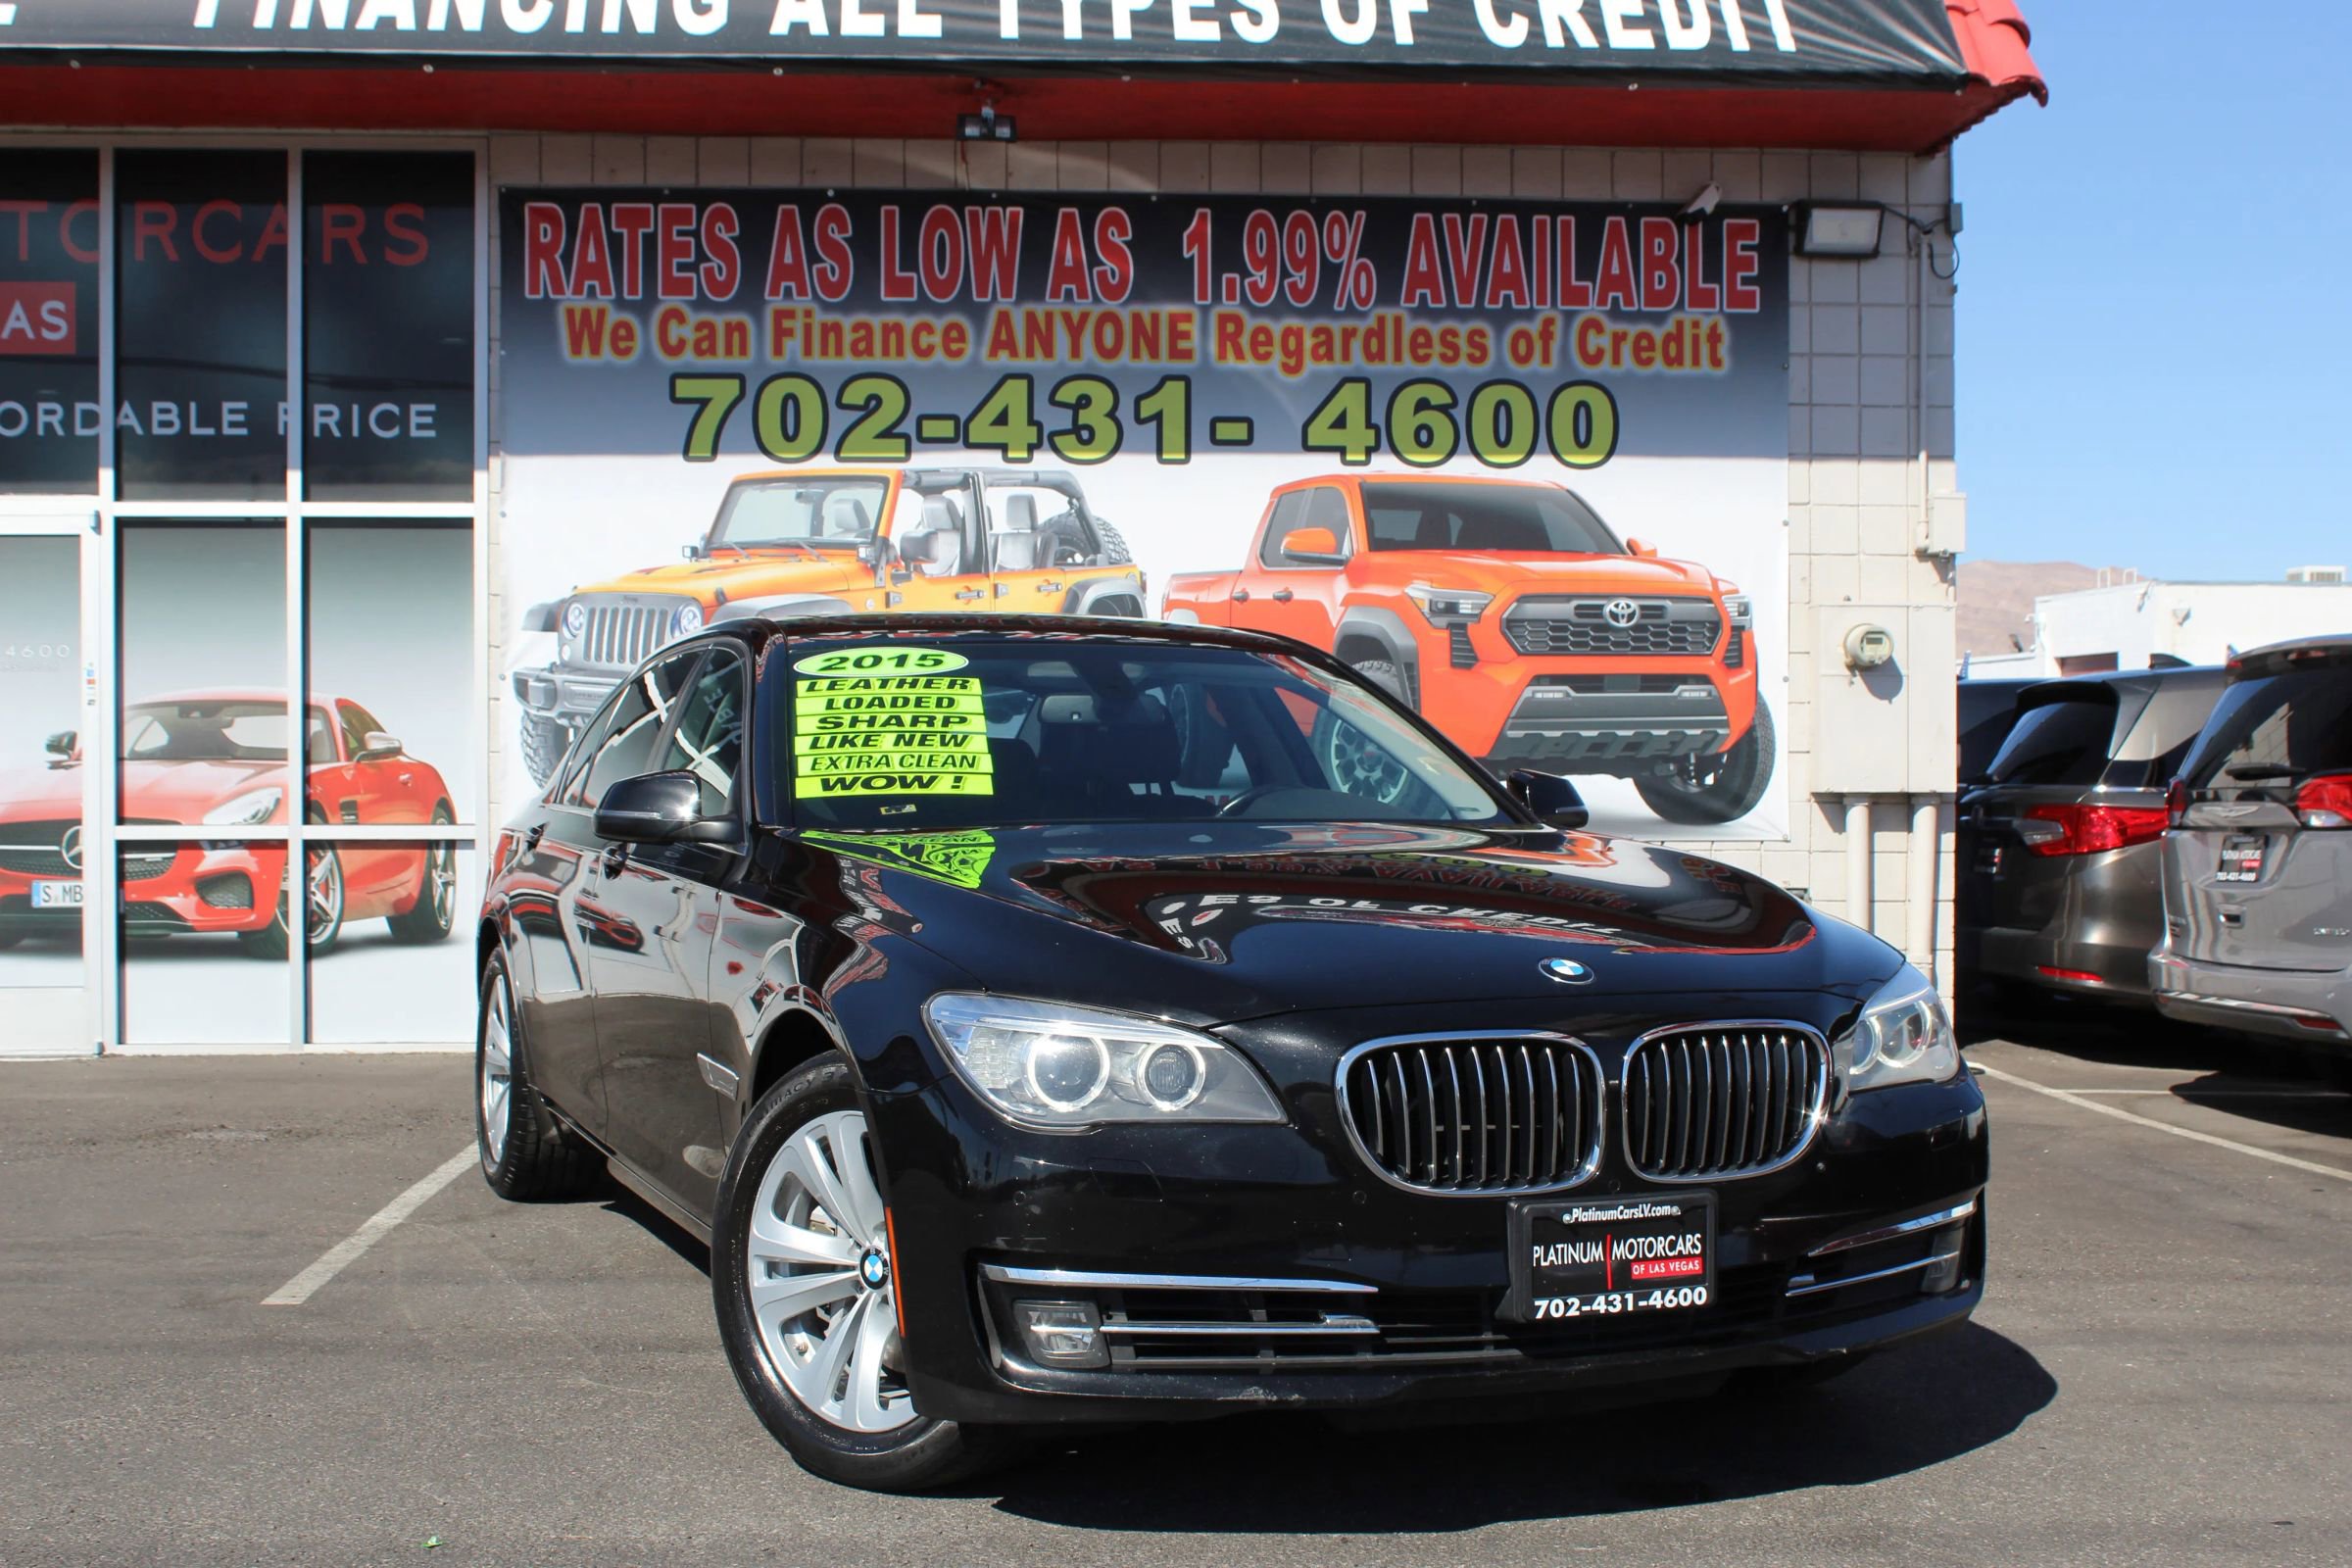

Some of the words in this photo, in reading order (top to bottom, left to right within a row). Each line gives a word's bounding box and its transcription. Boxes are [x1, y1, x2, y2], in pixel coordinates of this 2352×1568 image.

[523, 201, 742, 301] RATES
[764, 203, 854, 302] AS
[879, 204, 1024, 303] LOW
[1046, 206, 1133, 304] AS
[1183, 208, 1376, 311] 1.99%
[1400, 213, 1761, 314] AVAILABLE
[0, 299, 69, 341] AS
[563, 306, 638, 362] We
[657, 306, 752, 361] Can
[770, 306, 969, 362] Finance
[987, 308, 1195, 363] ANYONE
[1216, 310, 1491, 378] Regardless
[1509, 313, 1558, 368] of
[1576, 317, 1727, 371] Credit
[816, 654, 945, 671] 2015
[806, 677, 971, 693] LEATHER
[824, 696, 956, 711] LOADED
[815, 714, 969, 730] SHARP
[808, 735, 881, 751] LIKE
[893, 733, 970, 748] NEW
[810, 755, 892, 771] EXTRA
[899, 754, 978, 769] CLEAN
[1571, 1203, 1671, 1223] PlatinumCarsLV.com
[1533, 1241, 1604, 1267] PLATINUM
[1612, 1233, 1701, 1261] MOTORCARS
[1633, 1264, 1645, 1275] OF
[1649, 1262, 1666, 1274] LAS
[1669, 1260, 1700, 1272] VEGAS
[1535, 1287, 1707, 1320] 702-431-4600
